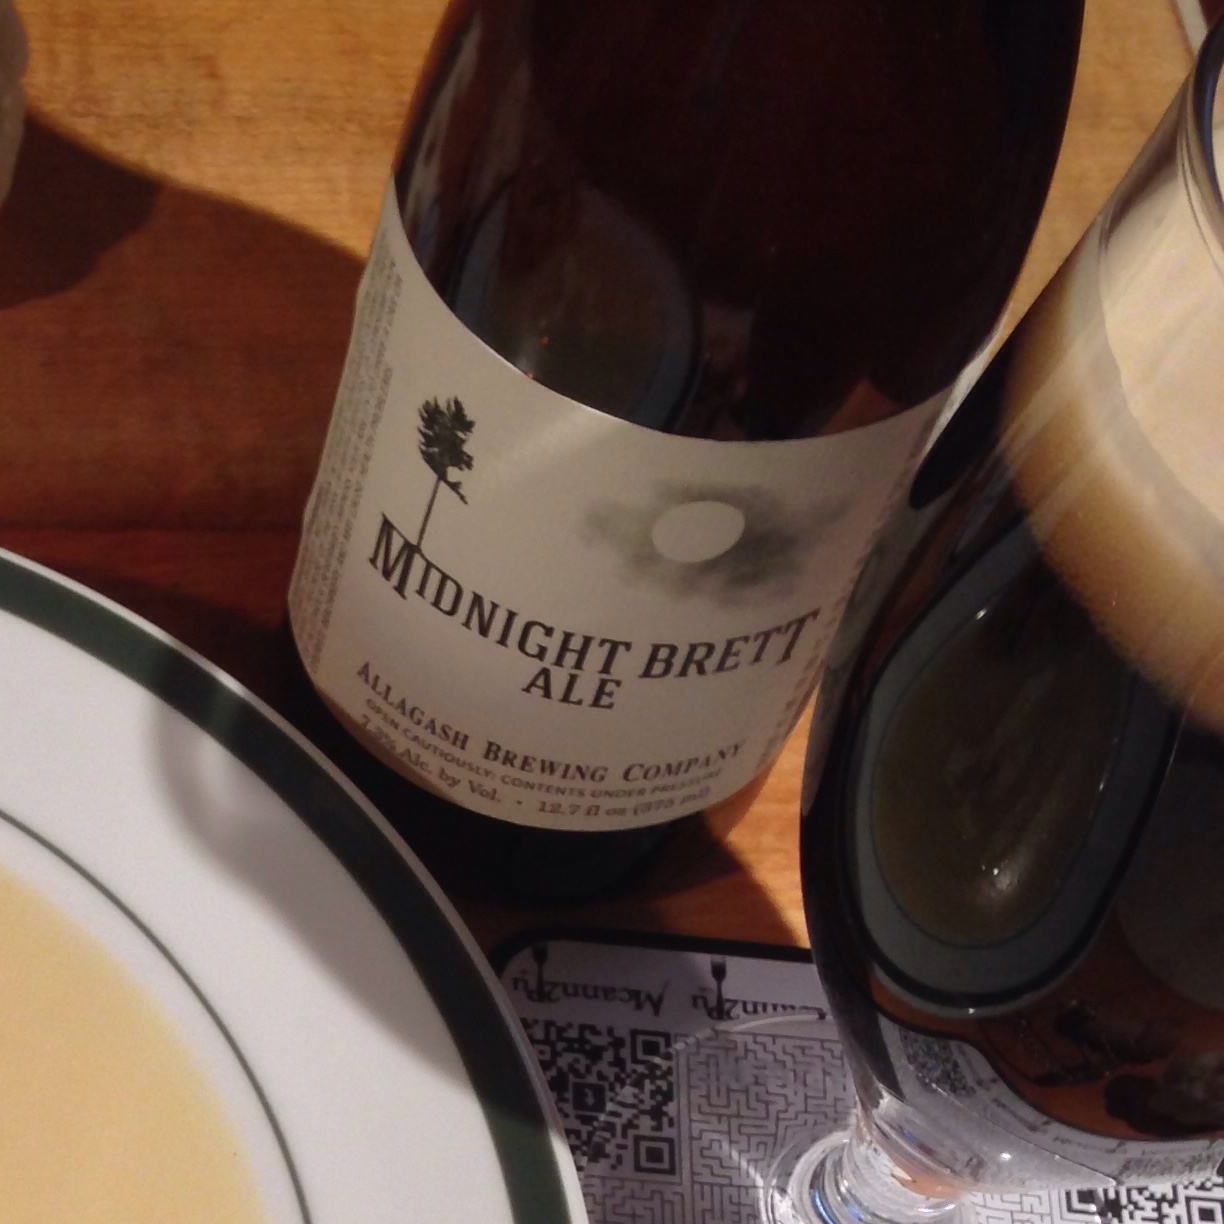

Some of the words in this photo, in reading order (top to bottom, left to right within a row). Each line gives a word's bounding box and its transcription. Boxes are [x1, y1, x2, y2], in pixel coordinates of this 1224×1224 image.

[368, 512, 631, 677] MIDNIGHT
[639, 609, 820, 681] BRETT
[357, 661, 470, 751] ALLAGASH
[483, 740, 609, 783] BREWING
[623, 739, 746, 783] COMPANY
[522, 666, 624, 710] ALE
[438, 767, 462, 789] by
